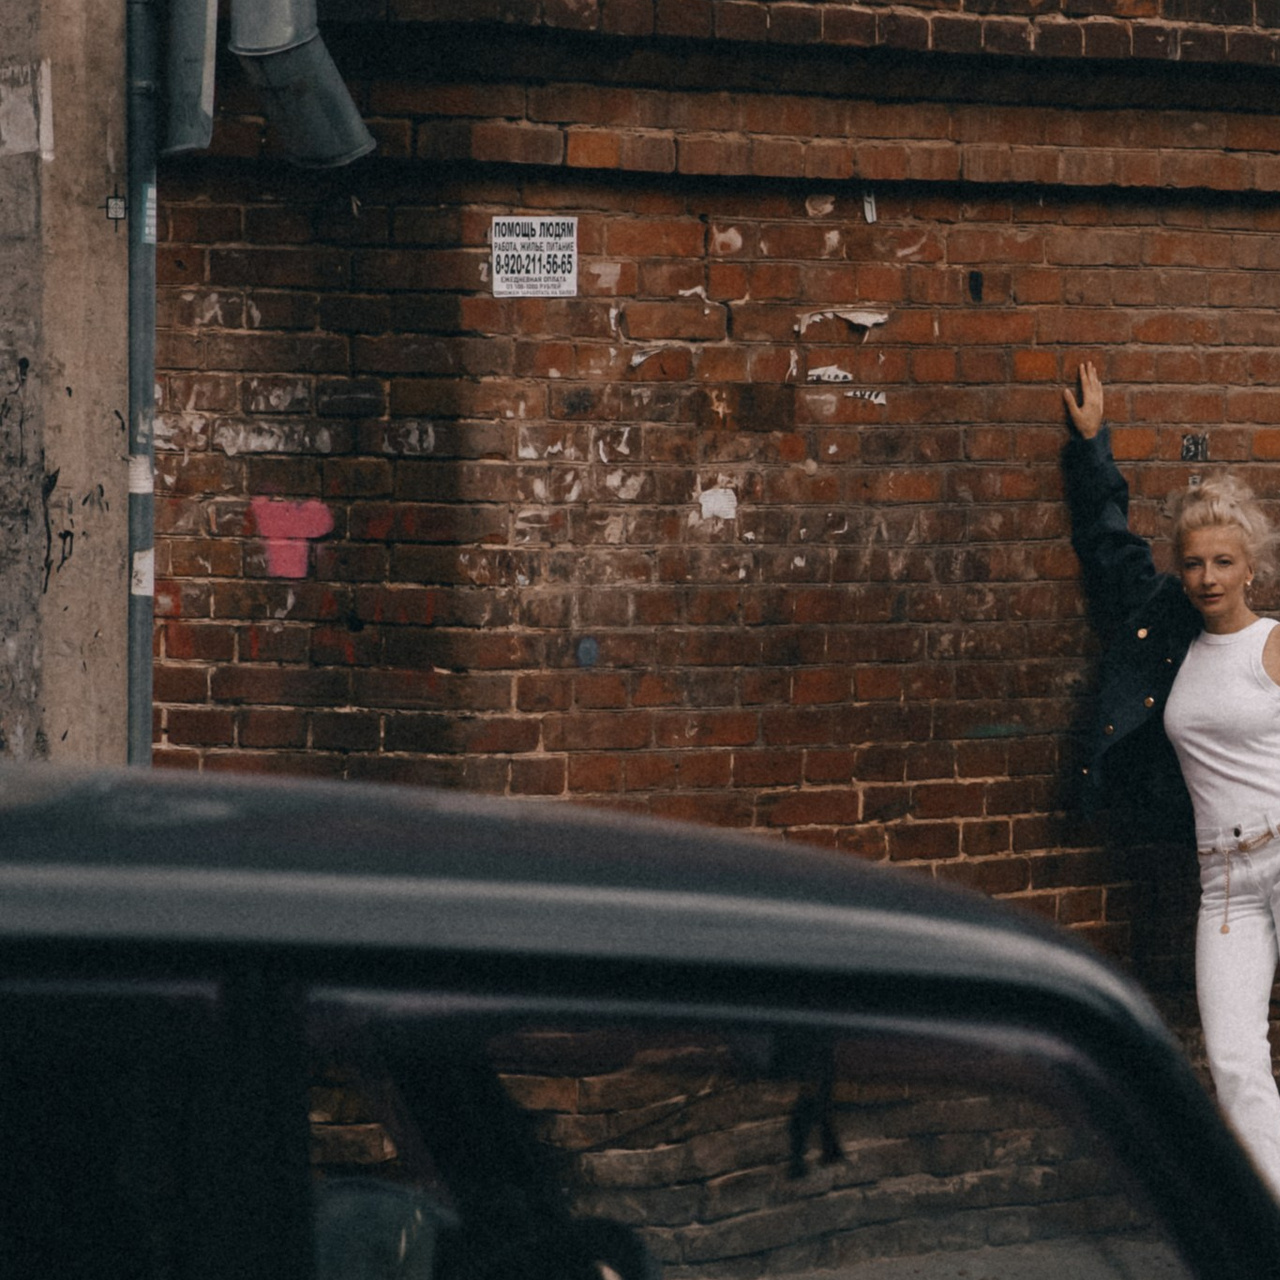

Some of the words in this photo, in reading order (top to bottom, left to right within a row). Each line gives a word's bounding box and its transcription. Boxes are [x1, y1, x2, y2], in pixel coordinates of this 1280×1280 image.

[494, 222, 537, 240] ПОМОЩЬ
[539, 222, 574, 240] ЛЮДЯМ
[494, 241, 518, 252] РАБОТА,
[546, 241, 574, 252] ПИТАНИЕ
[495, 253, 573, 274] 8-920-211-56-65
